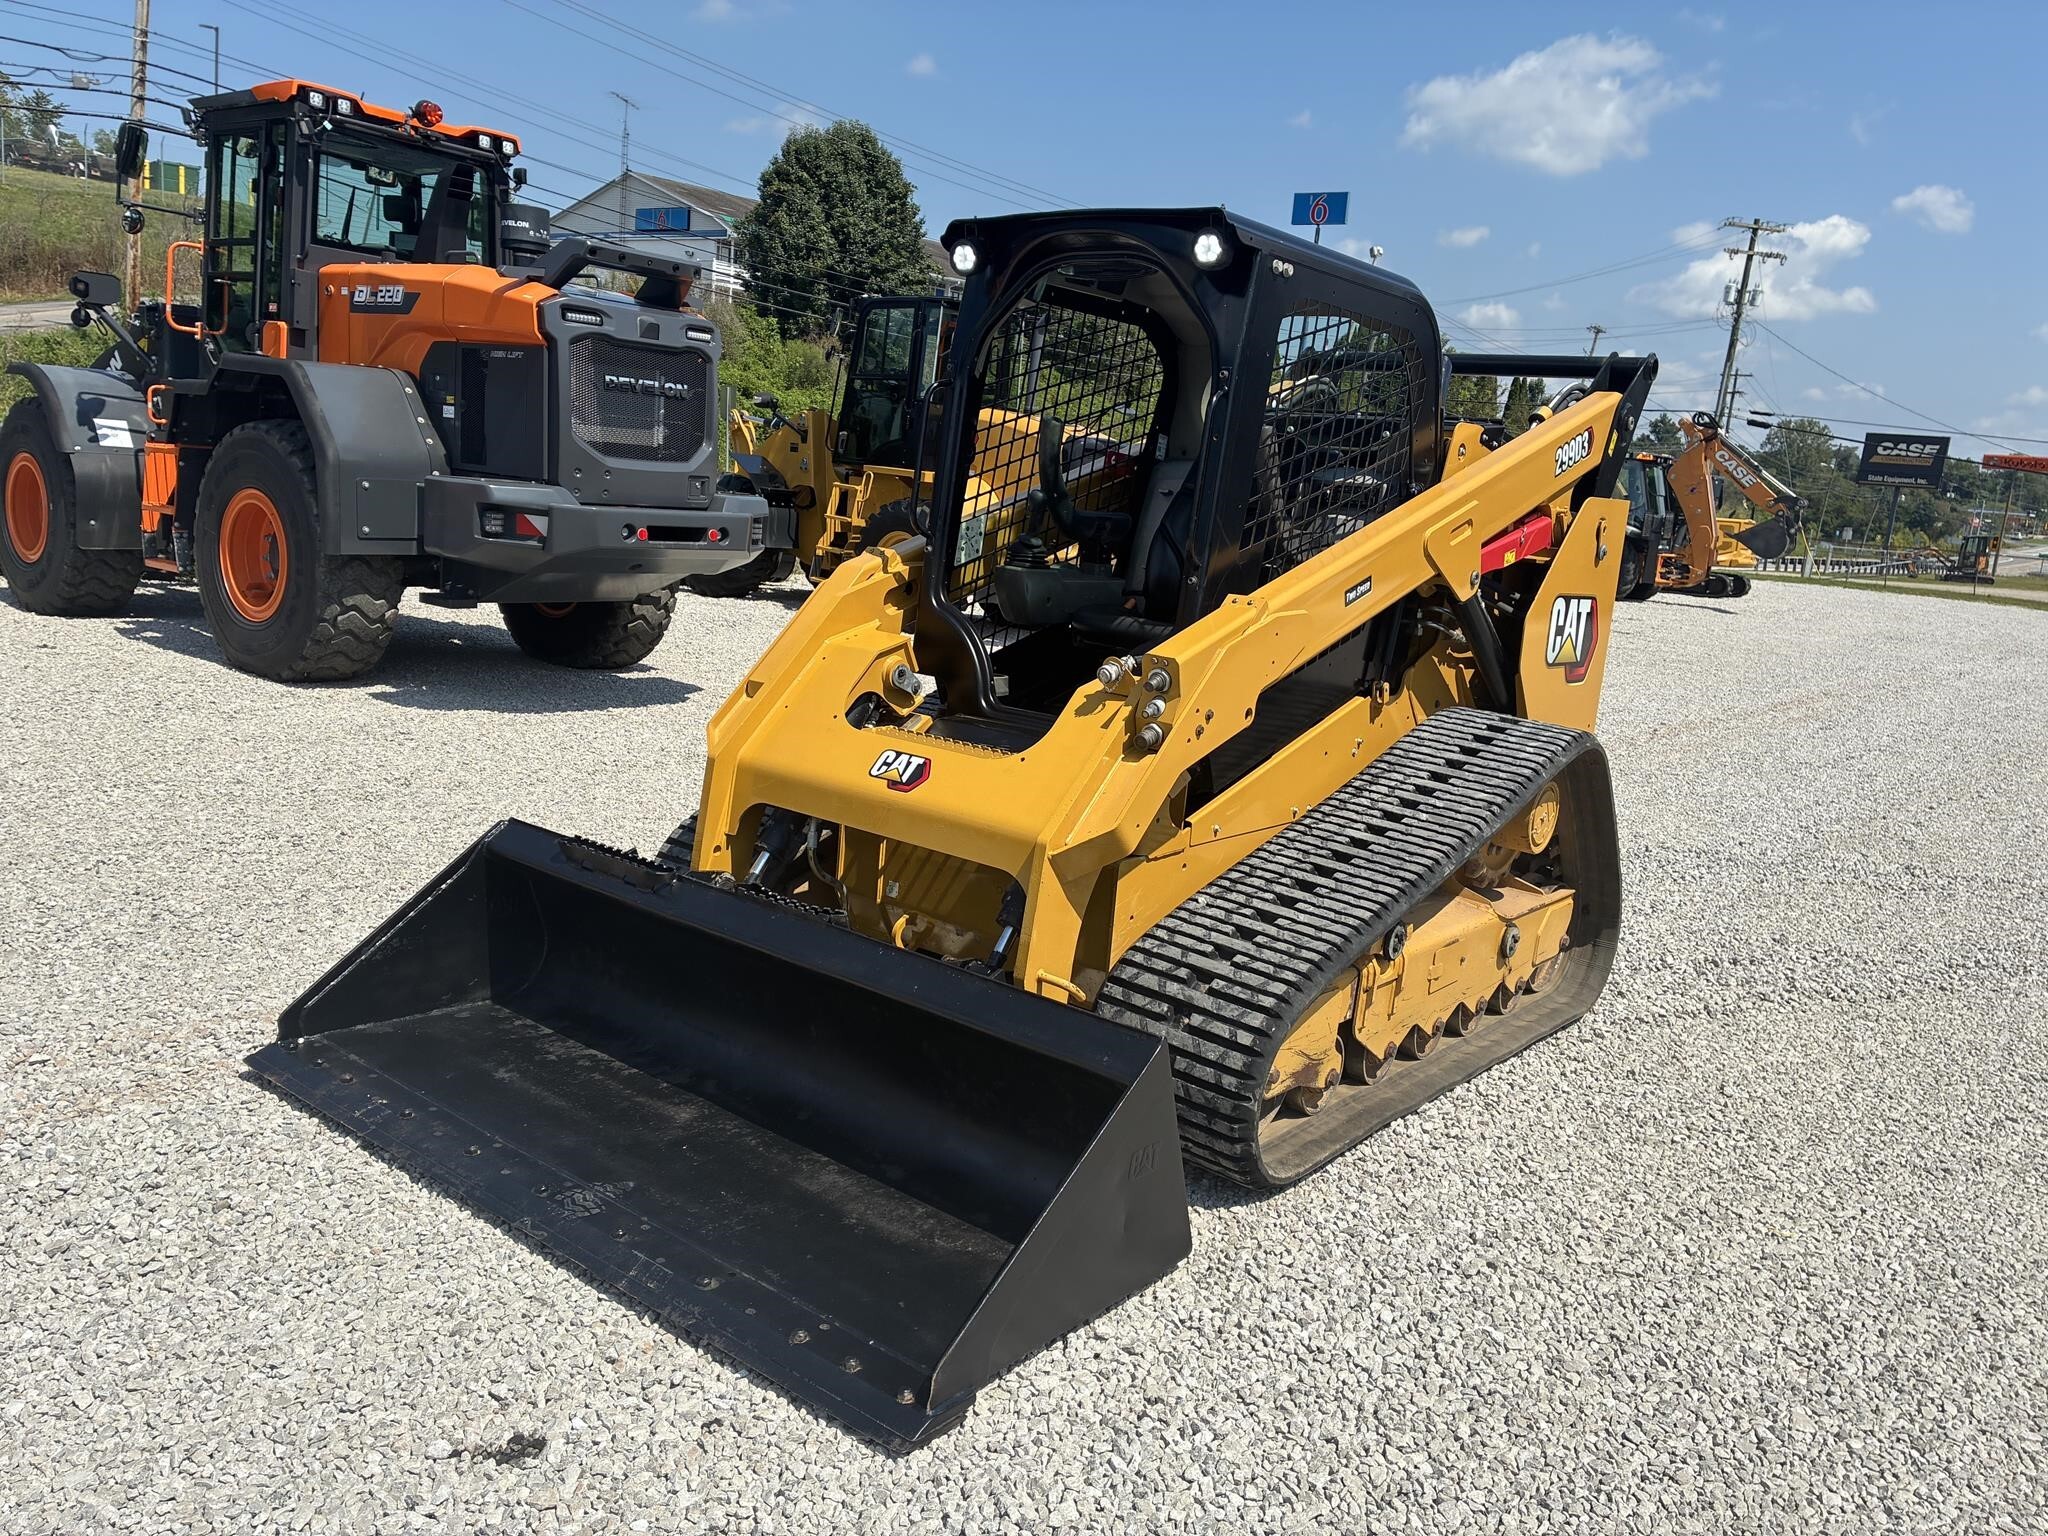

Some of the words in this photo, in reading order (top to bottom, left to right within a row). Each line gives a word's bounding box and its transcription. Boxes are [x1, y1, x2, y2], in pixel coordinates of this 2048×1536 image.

[1310, 193, 1329, 225] 6
[604, 375, 688, 399] DEVELON
[1555, 430, 1589, 476] 299D3
[1876, 441, 1940, 458] CASE
[1715, 450, 1757, 488] CASE
[1867, 474, 1883, 482] State
[1546, 597, 1592, 664] CAT
[870, 750, 926, 783] CAT
